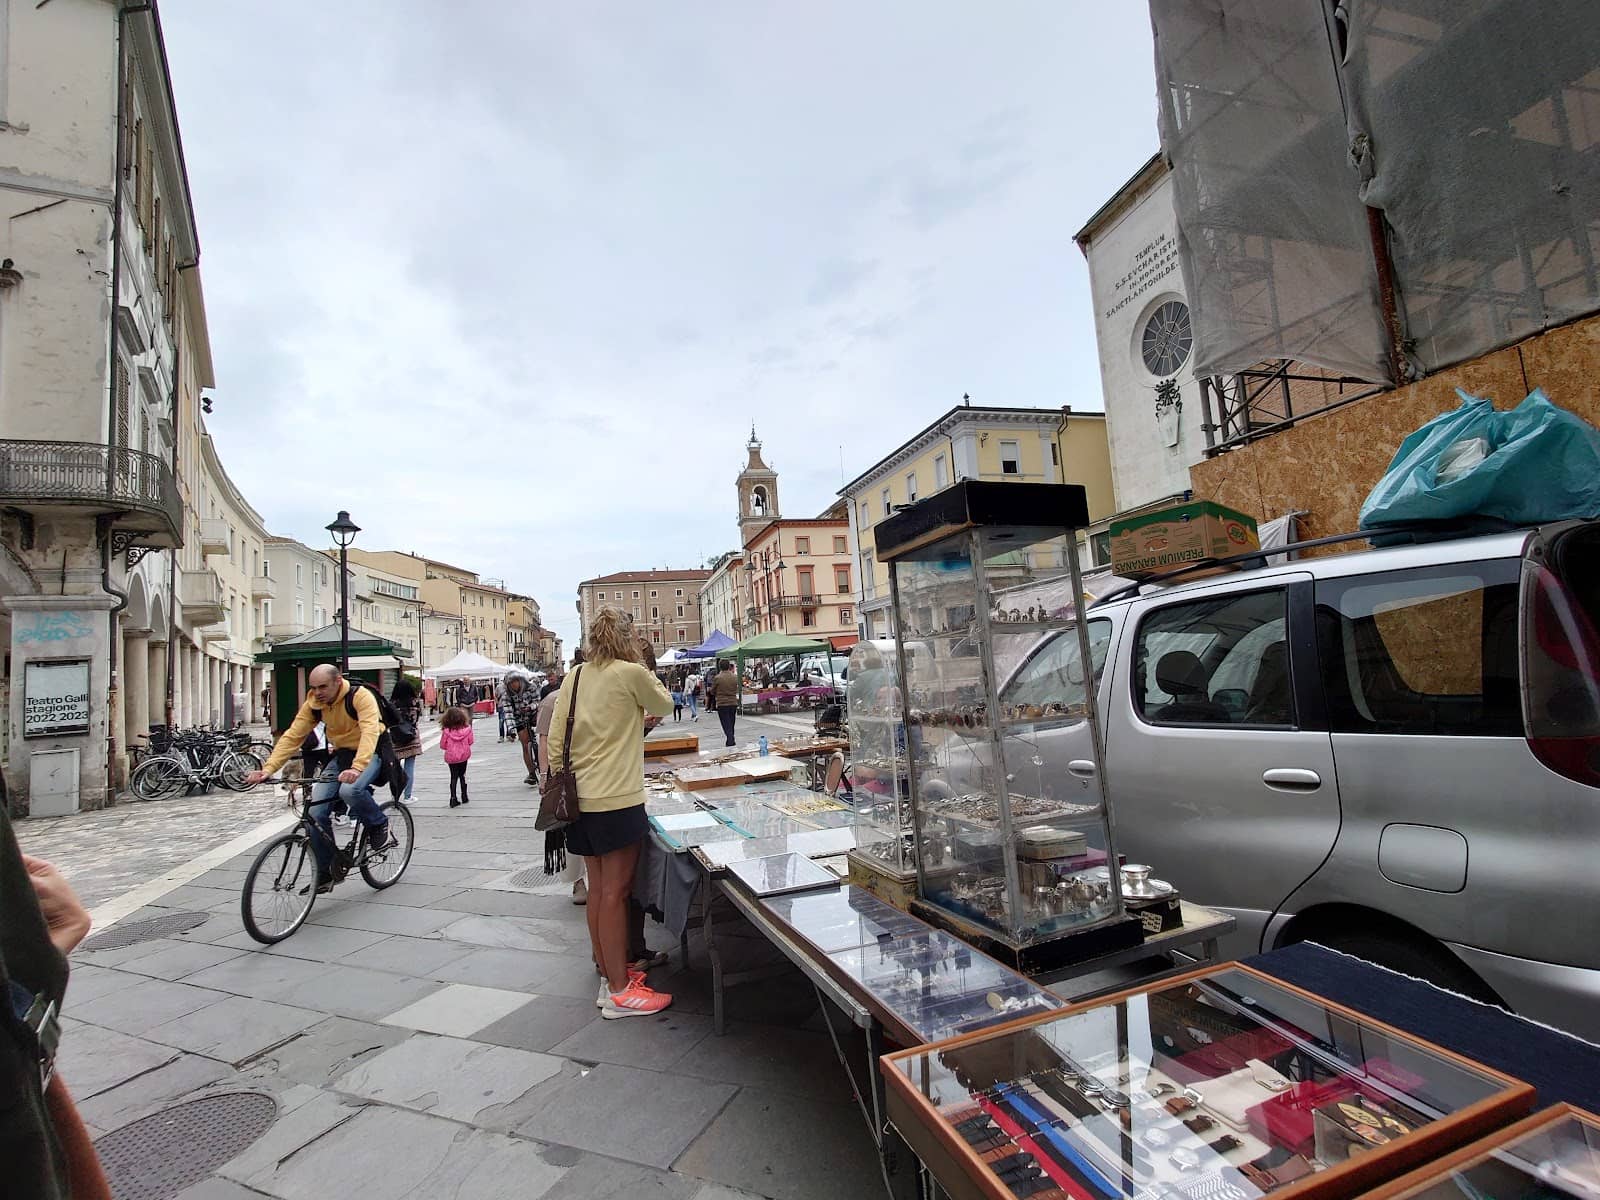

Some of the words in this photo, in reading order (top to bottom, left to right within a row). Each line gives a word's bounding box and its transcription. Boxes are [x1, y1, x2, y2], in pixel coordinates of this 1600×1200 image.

[1159, 548, 1204, 564] PREMIUM
[1114, 557, 1156, 573] BANANAS
[26, 697, 63, 705] Teatro
[64, 694, 89, 703] Galli
[26, 704, 78, 714] stagione
